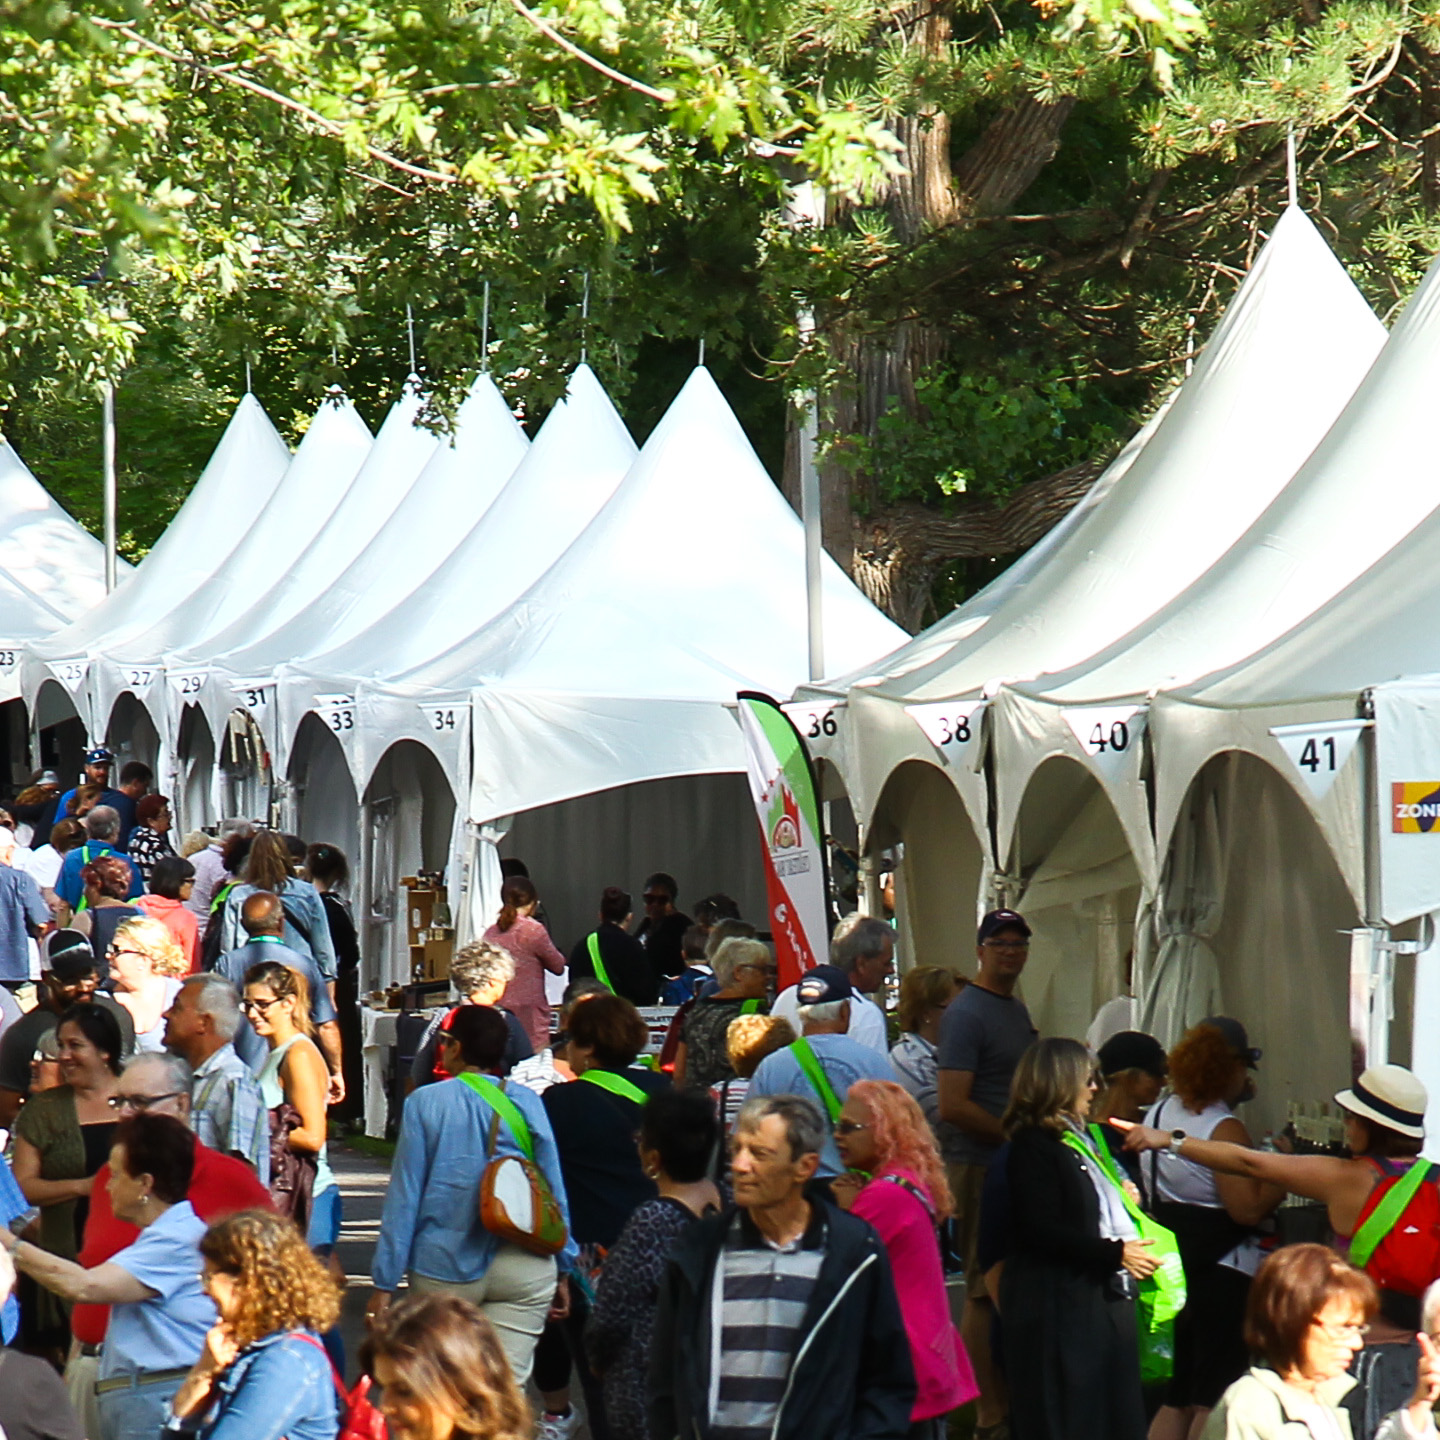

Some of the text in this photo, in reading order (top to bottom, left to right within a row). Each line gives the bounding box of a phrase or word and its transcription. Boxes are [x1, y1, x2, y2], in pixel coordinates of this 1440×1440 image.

[0, 652, 15, 666] 23
[66, 665, 82, 680] 25
[132, 672, 150, 686] 27
[182, 676, 201, 694] 29
[246, 688, 266, 707] 31
[331, 710, 354, 731] 33
[436, 710, 455, 730] 34
[808, 710, 838, 738] 36
[938, 715, 972, 746] 38
[1089, 720, 1130, 753] 40
[1299, 737, 1336, 773] 41
